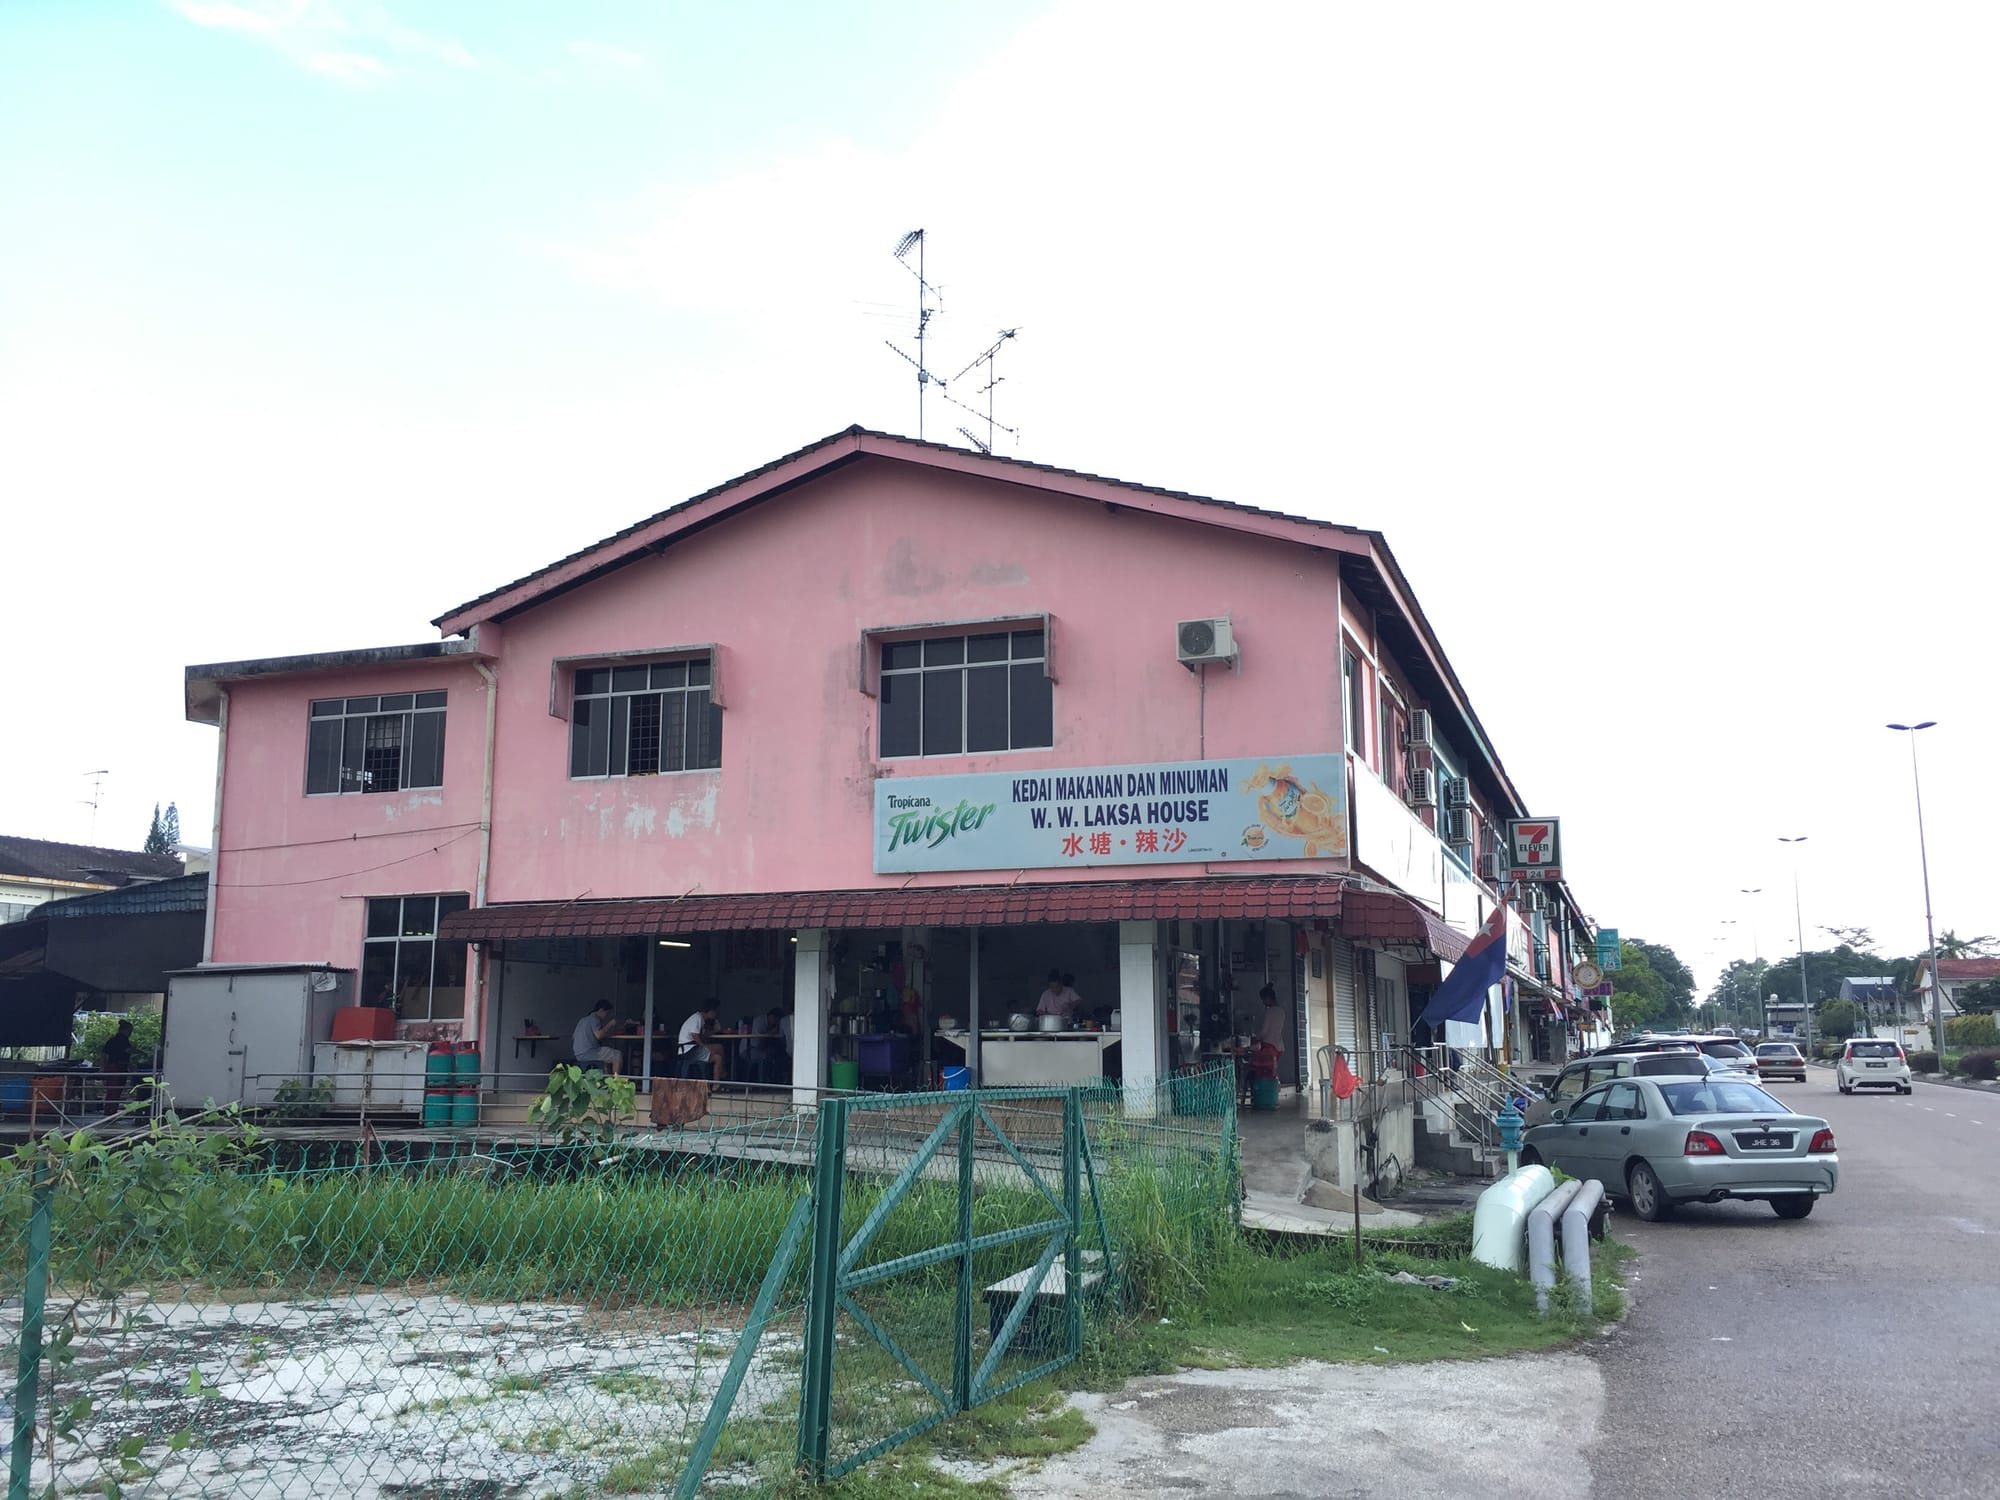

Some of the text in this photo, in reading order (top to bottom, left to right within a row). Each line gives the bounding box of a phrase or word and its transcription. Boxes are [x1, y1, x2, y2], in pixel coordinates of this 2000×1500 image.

[1012, 768, 1228, 802] KEDAI MAKANAN DAN MINUMAN
[887, 795, 931, 809] Tropicana
[1084, 803, 1142, 827] LAKSA
[1147, 799, 1209, 824] HOUSE
[887, 799, 996, 852] Twister
[1518, 825, 1548, 863] 7
[1530, 871, 1542, 879] 24
